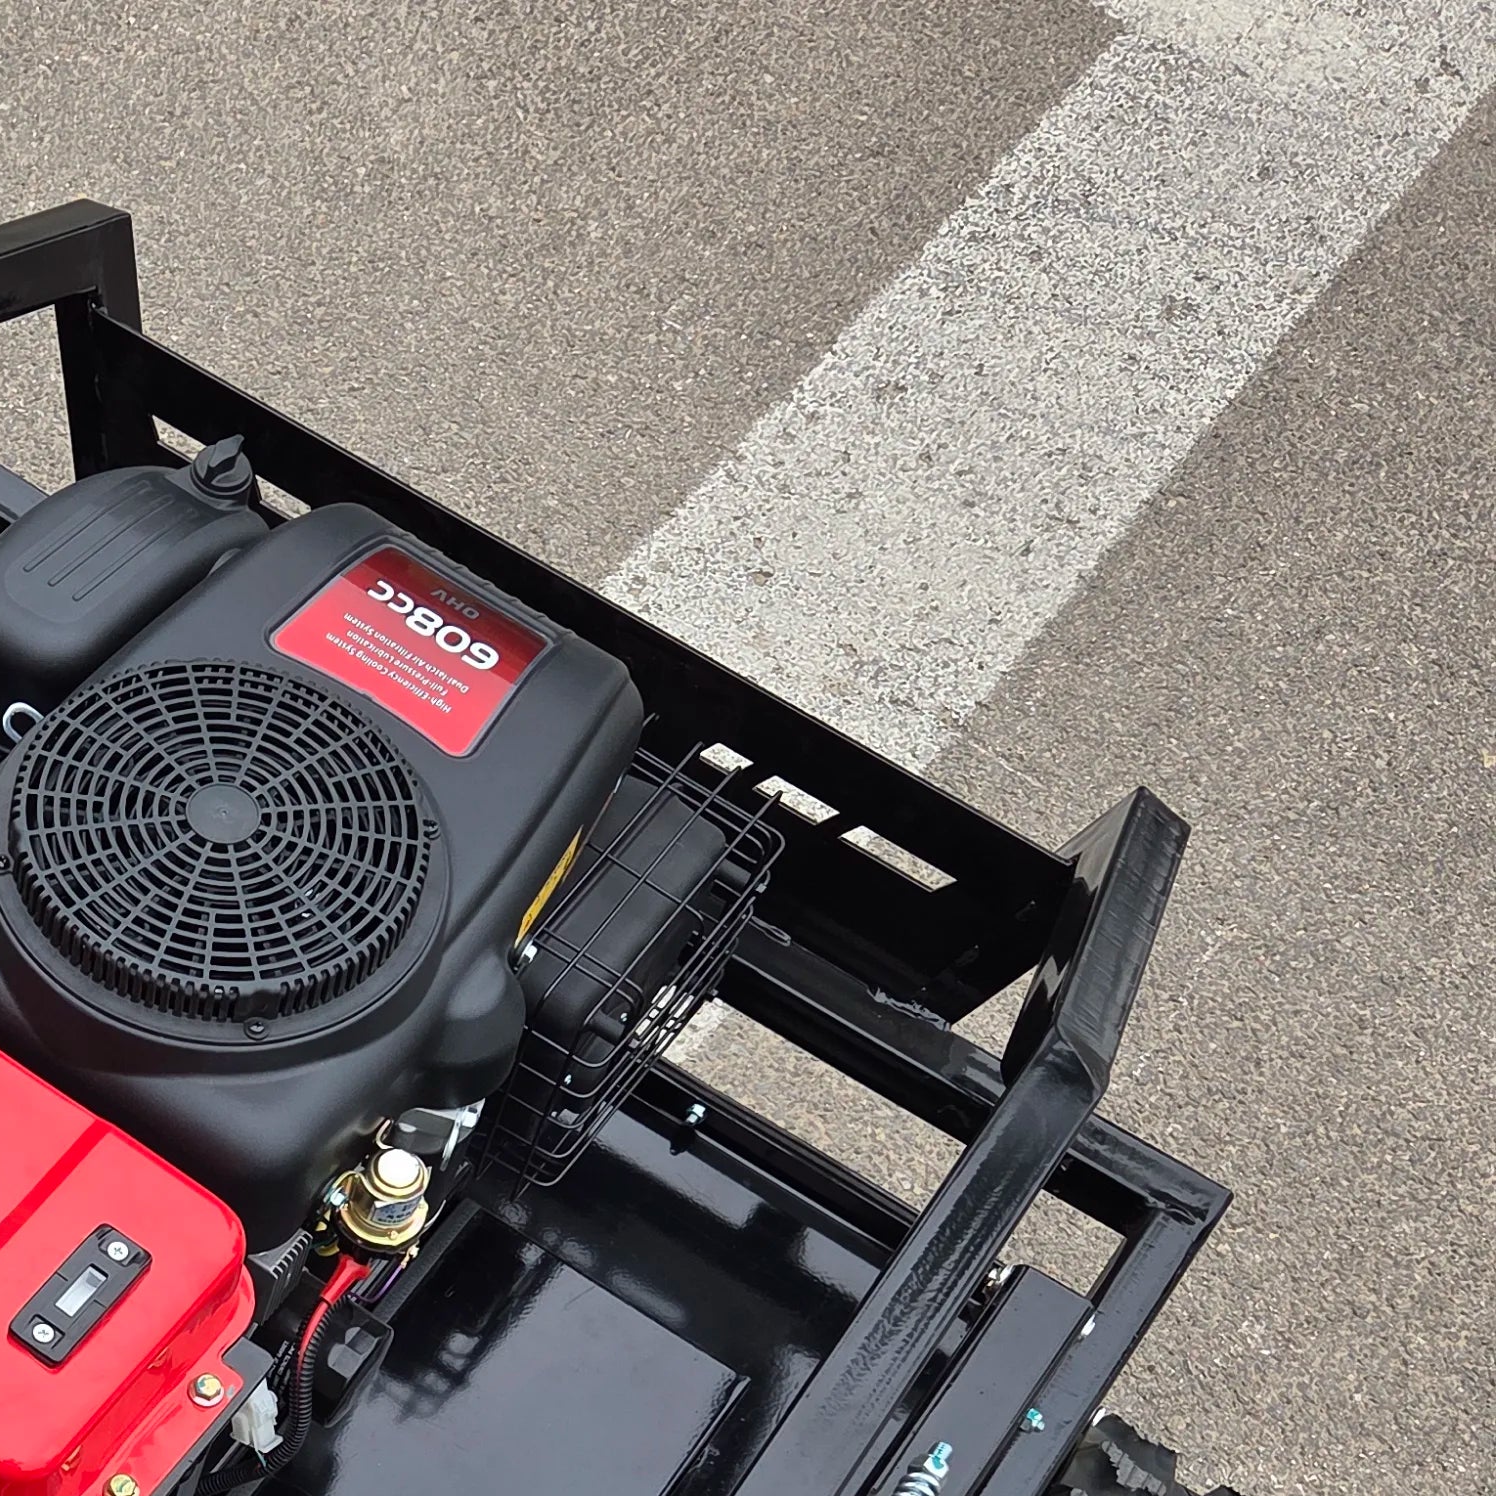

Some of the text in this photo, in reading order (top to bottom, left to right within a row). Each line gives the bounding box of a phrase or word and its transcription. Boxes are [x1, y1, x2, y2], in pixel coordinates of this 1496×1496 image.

[430, 588, 480, 620] OHV
[343, 612, 375, 637] System
[367, 580, 500, 670] 608cc
[374, 631, 413, 660] Filtration
[410, 653, 427, 668] Air
[326, 632, 452, 713] High-Efficiency Cooling System
[346, 630, 449, 697] Full-Pressure Lubrication
